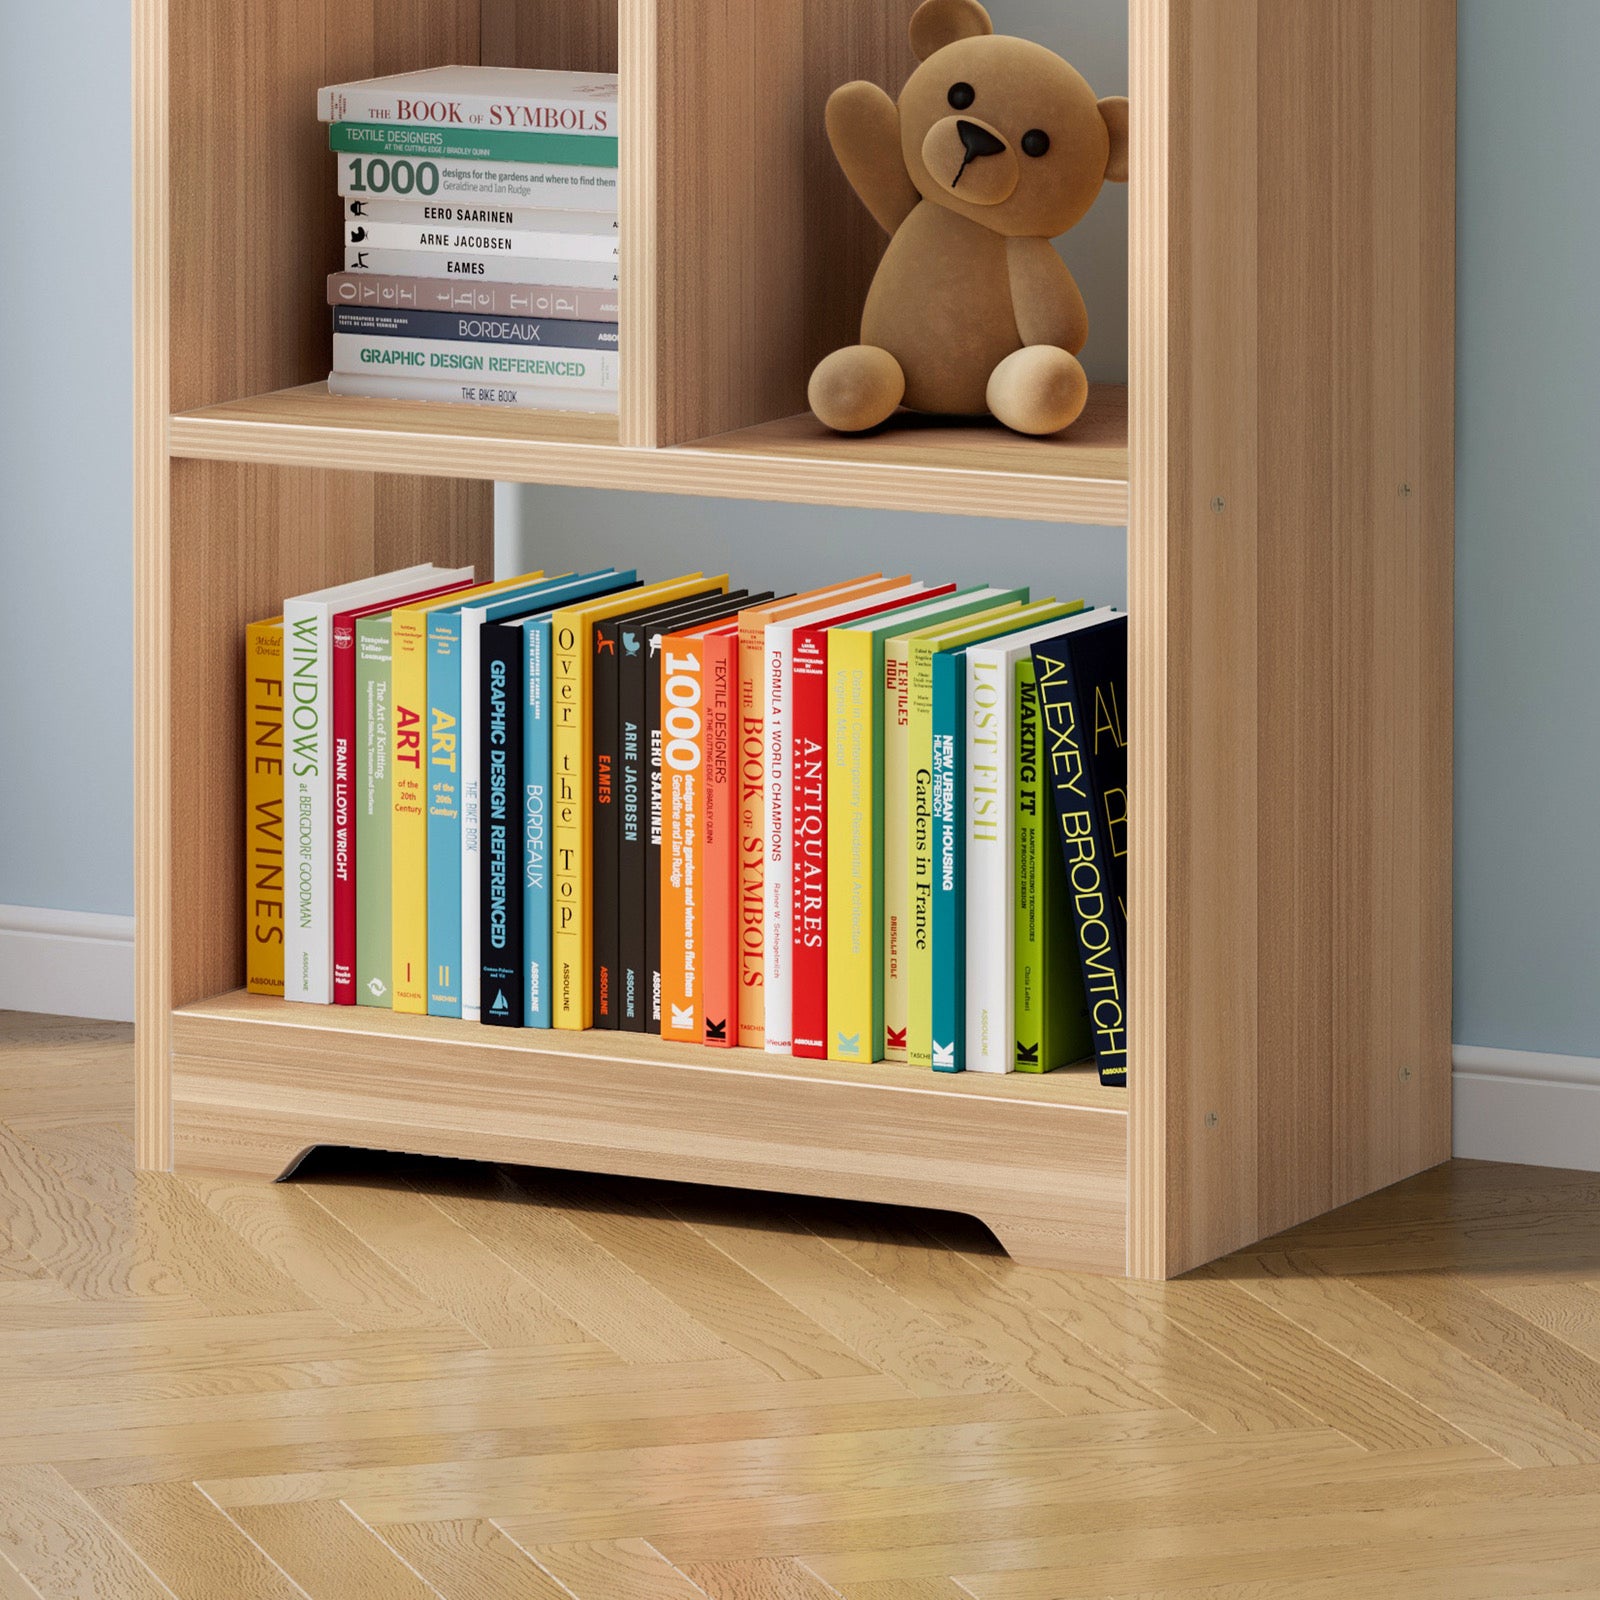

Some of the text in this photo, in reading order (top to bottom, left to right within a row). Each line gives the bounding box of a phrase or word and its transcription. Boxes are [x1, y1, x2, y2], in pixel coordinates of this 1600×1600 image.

[346, 128, 443, 145] TEXTILE DESIGNERS
[368, 99, 608, 132] THE BOOK OF SYMBOLS
[349, 157, 440, 196] 1000
[442, 168, 616, 187] designs for the gardens and where to find them
[443, 180, 531, 197] Geraldine and Ian Rudge
[420, 233, 512, 250] ARNE JACOBSEN
[424, 207, 514, 224] EERO SAARINEN
[338, 282, 575, 313] Over the Top
[447, 261, 485, 276] EAMES
[360, 348, 426, 367] GRAPHIC
[430, 353, 484, 371] DESIGN
[488, 356, 586, 377] REFERENCED
[459, 320, 541, 341] BORDEAUX
[461, 387, 518, 403] THE BIKE BOOK
[665, 651, 701, 770] 1000
[706, 707, 713, 717] AT
[771, 651, 781, 715] FORMULA
[898, 661, 908, 726] TEXTILES
[375, 681, 386, 779] The Art of Knitting
[397, 705, 420, 769] ART
[431, 707, 456, 773] ART
[715, 658, 726, 784] TEXTILE DESIGNERS
[835, 670, 847, 767] Virginia McLeod
[1020, 682, 1036, 816] MAKING IT
[292, 616, 318, 928] WINDOWS at BERGDORF GOODMAN
[407, 780, 419, 789] the
[559, 628, 574, 928] Over the Top
[599, 755, 610, 804] EAMES
[625, 722, 637, 841] ARNE JACOBSEN
[771, 730, 781, 779] WORLD
[933, 735, 942, 817] HILARY FRENCH
[973, 662, 998, 843] LOST FISH
[255, 678, 283, 944] FINE WINES
[336, 738, 347, 880] FRANK LLOYD WRIGHT
[395, 803, 422, 815] Century
[401, 792, 416, 800] 20th
[466, 781, 477, 851] THE BIKE BOOK
[490, 660, 505, 948] GRAPHIC DESIGN REFERENCED
[651, 772, 661, 845] SAARINEN
[771, 783, 781, 862] CHAMPIONS
[850, 670, 863, 954] Detail in Contemporary Residential Architecture
[942, 734, 953, 891] NEW URBAN HOUSING
[527, 785, 543, 888] BORDEAUX
[670, 774, 682, 888] Geraldine and Ian Rudge
[743, 678, 764, 987] THE BOOK OF SYMBOLS
[802, 737, 822, 947] ANTIQUAIRES
[916, 769, 931, 950] Gardens in France
[1036, 654, 1086, 797] ALEXEY
[1062, 810, 1127, 1055] BRODOVITCH
[684, 774, 695, 997] designs for the gardens and where to find them
[773, 911, 780, 920] W.
[772, 923, 780, 978] Schlegelmilch
[397, 991, 421, 999] TASCHEN
[531, 961, 539, 1012] ASSOULINE
[600, 966, 608, 1015] ASSOULINE
[626, 969, 634, 1018] ASSOULINE
[653, 971, 661, 1020] ASSOULINE
